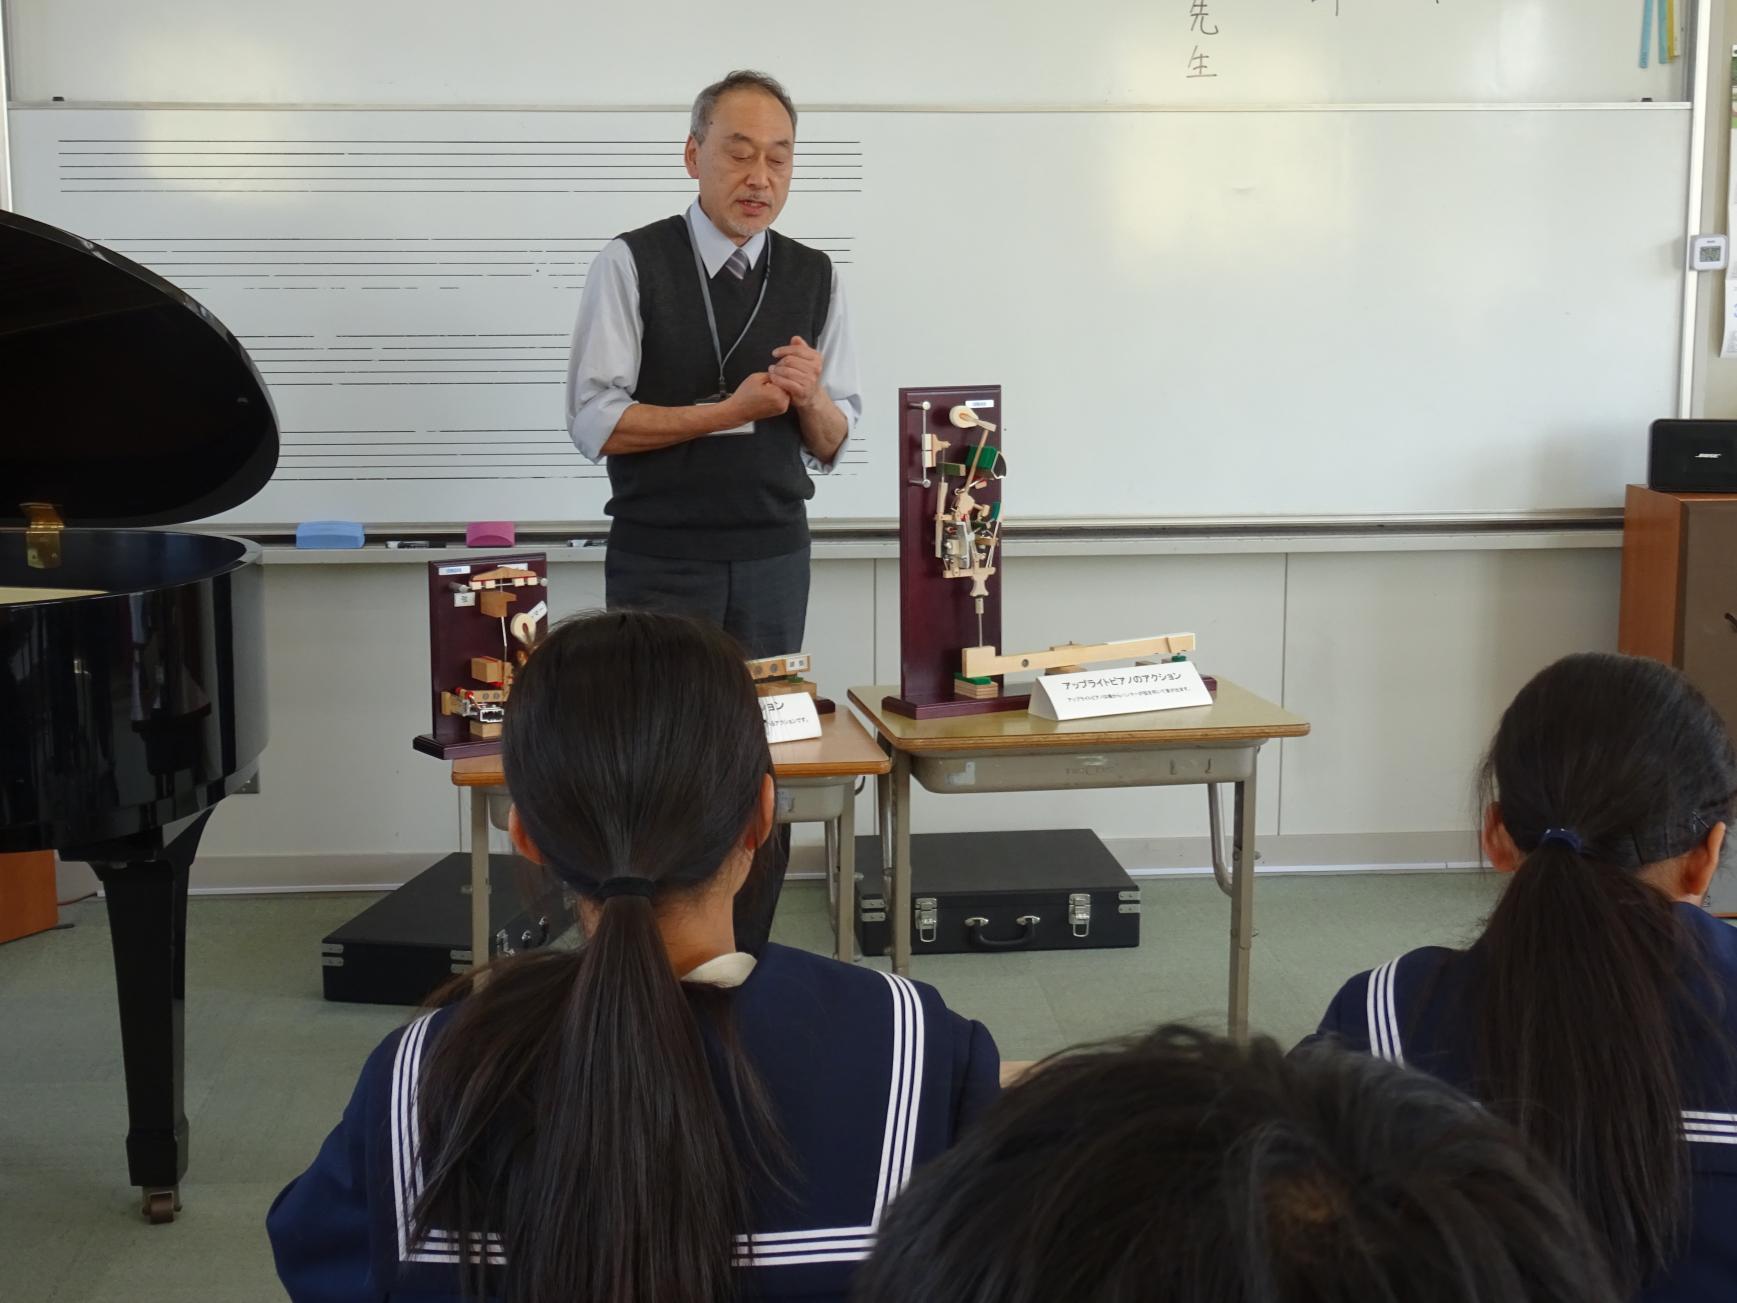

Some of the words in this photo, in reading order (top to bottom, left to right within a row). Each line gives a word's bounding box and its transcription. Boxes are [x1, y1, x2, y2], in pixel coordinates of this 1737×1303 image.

[1186, 0, 1219, 78] 先生
[1061, 672, 1182, 690] アップライトピアノのアクション
